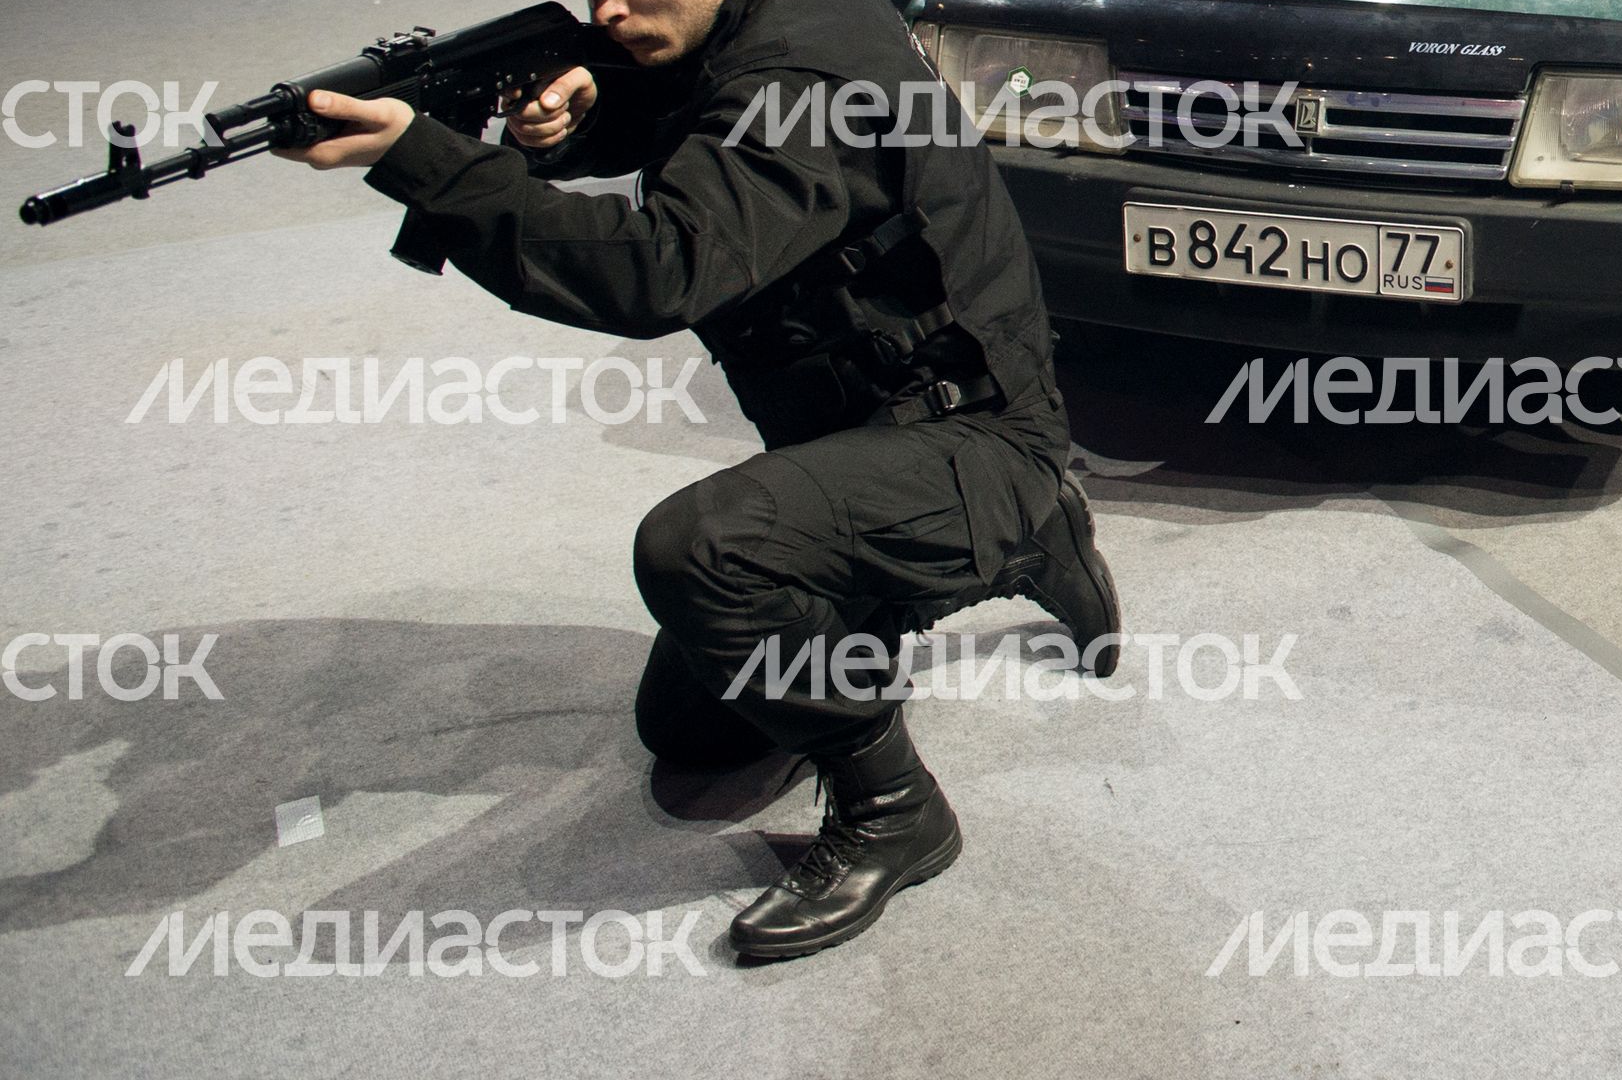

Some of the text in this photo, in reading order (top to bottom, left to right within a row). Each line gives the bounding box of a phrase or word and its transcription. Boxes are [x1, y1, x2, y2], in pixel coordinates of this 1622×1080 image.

[1408, 42, 1506, 56] VORON GLASS
[1386, 232, 1440, 274] 77
[1383, 274, 1423, 291] RUS
